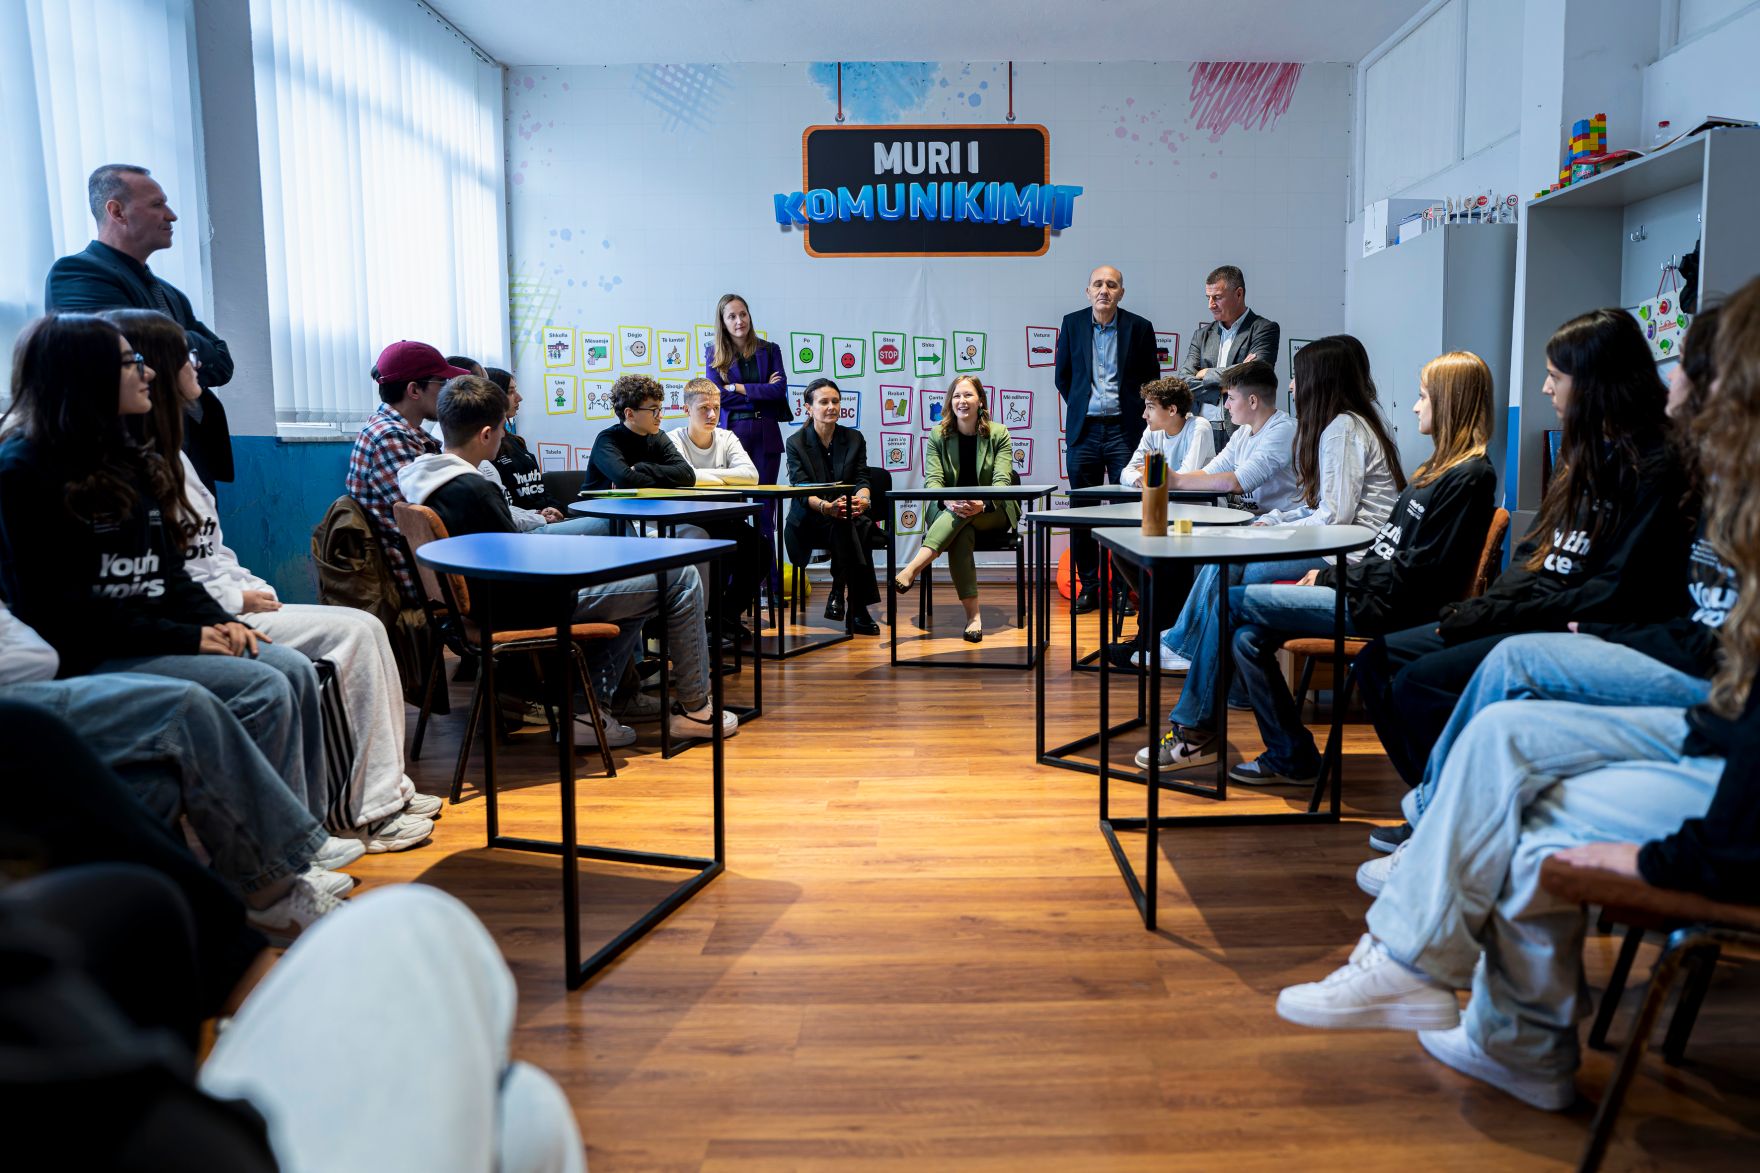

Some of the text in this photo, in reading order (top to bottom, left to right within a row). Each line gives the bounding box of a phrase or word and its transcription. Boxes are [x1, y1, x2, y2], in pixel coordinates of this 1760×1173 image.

[873, 140, 979, 175] MURI I
[773, 181, 1084, 230] KOMUNIKIMIT
[879, 350, 898, 359] STOP
